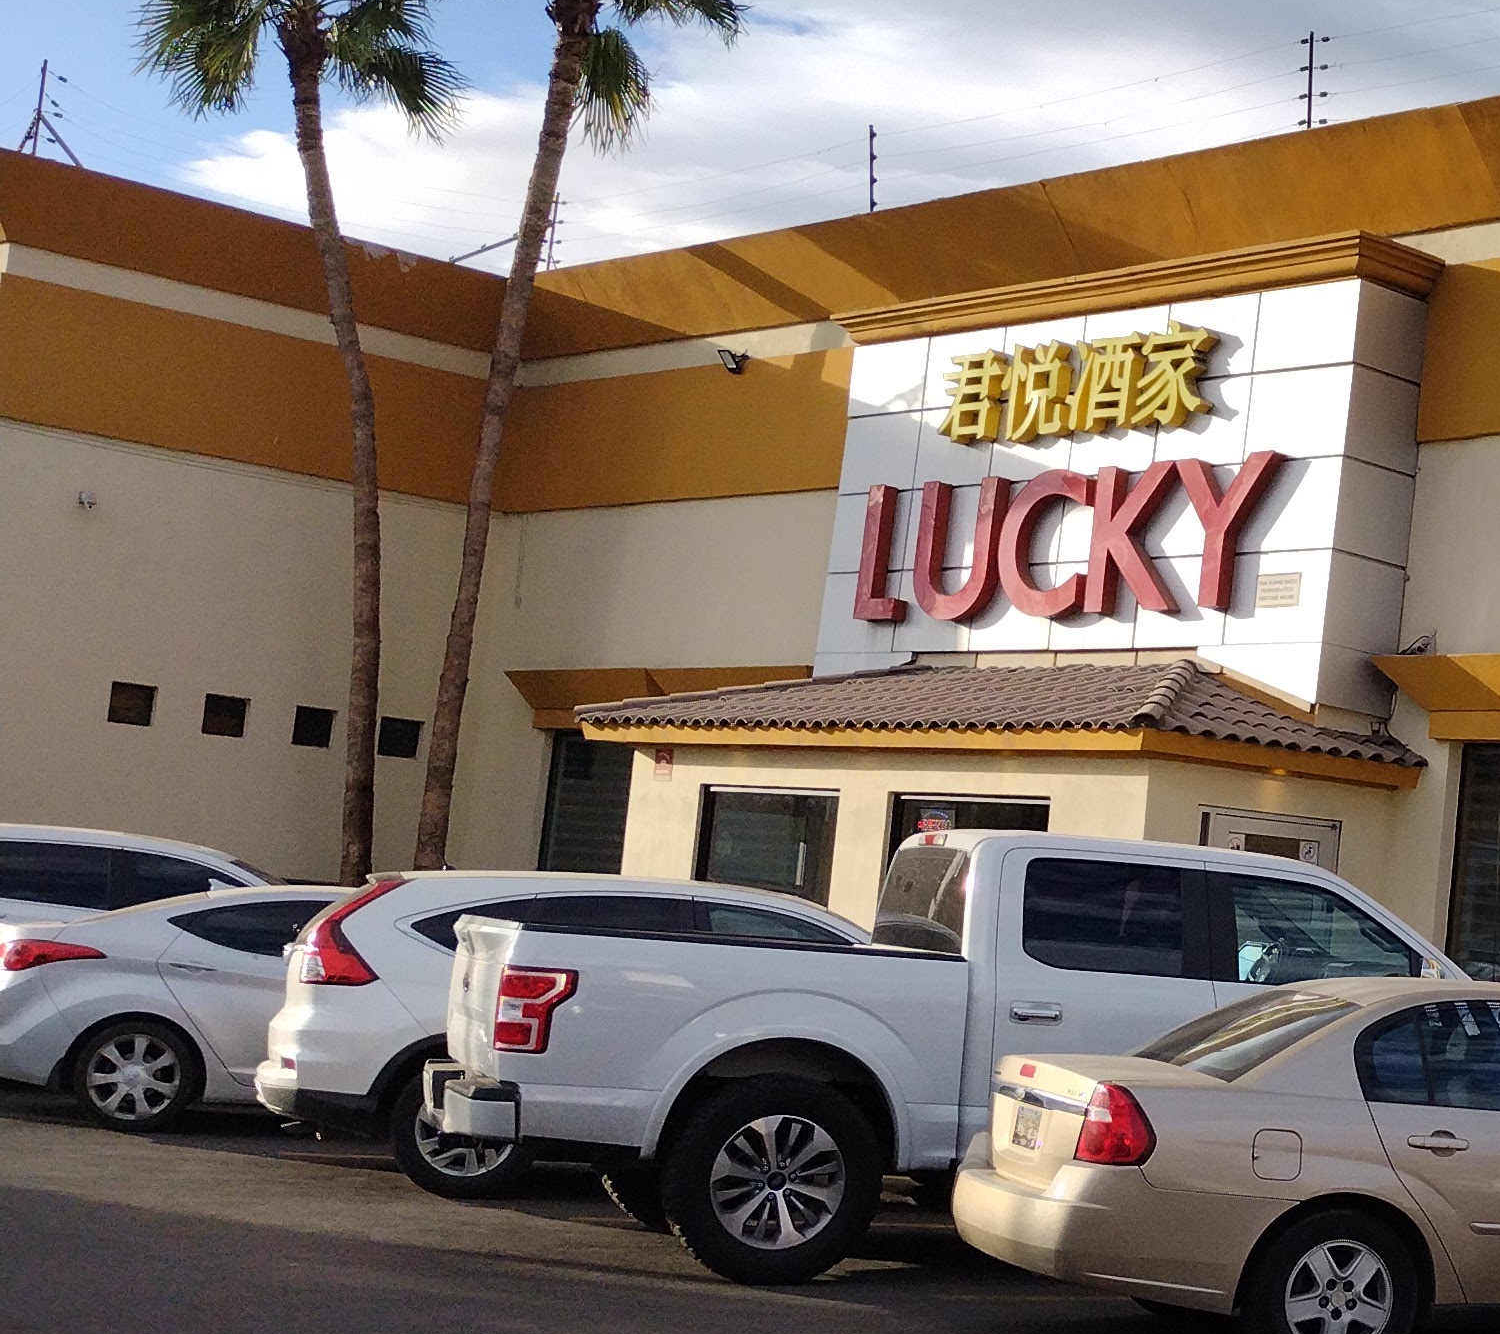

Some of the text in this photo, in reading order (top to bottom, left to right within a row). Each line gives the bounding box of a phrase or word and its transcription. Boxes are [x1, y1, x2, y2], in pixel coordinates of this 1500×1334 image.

[937, 319, 1217, 443] 君悦酒家
[853, 450, 1285, 620] LUCKY
